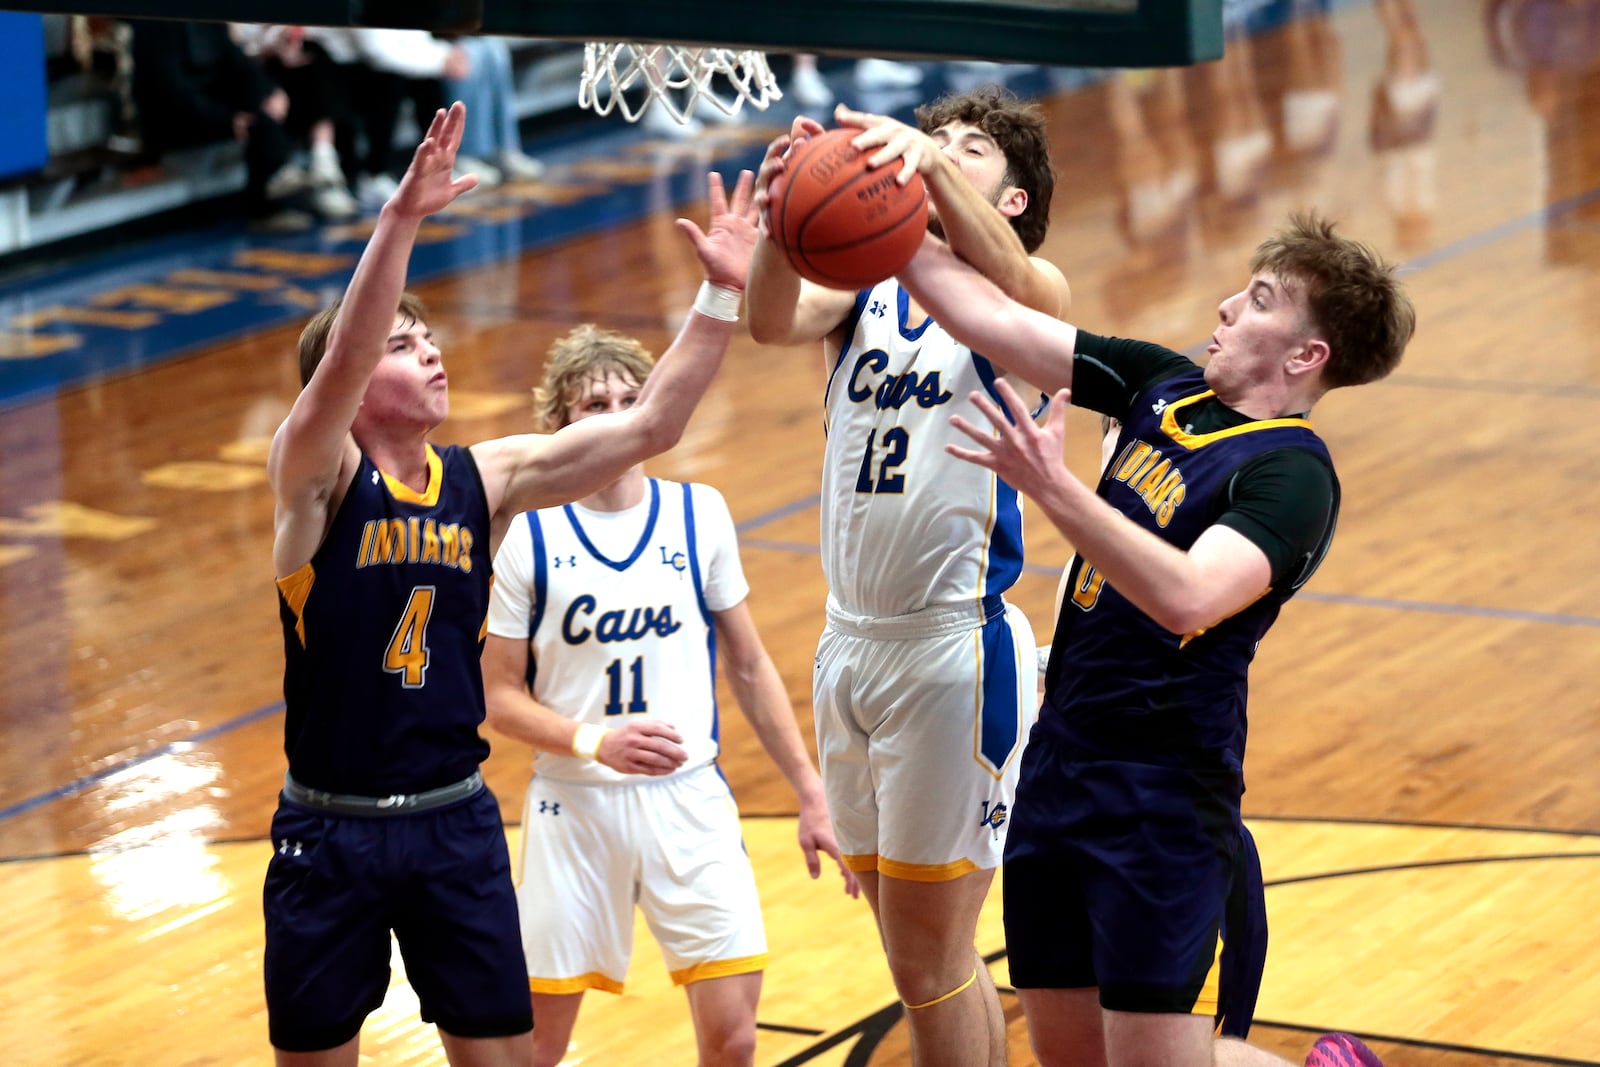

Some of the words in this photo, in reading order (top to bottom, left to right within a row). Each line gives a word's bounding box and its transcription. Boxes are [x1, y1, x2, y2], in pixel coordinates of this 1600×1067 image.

[848, 348, 953, 410] Cavs
[855, 425, 910, 494] 12
[356, 516, 473, 573] INDIANS
[382, 585, 436, 689] 4
[562, 593, 682, 646] Cavs
[604, 655, 648, 717] 11
